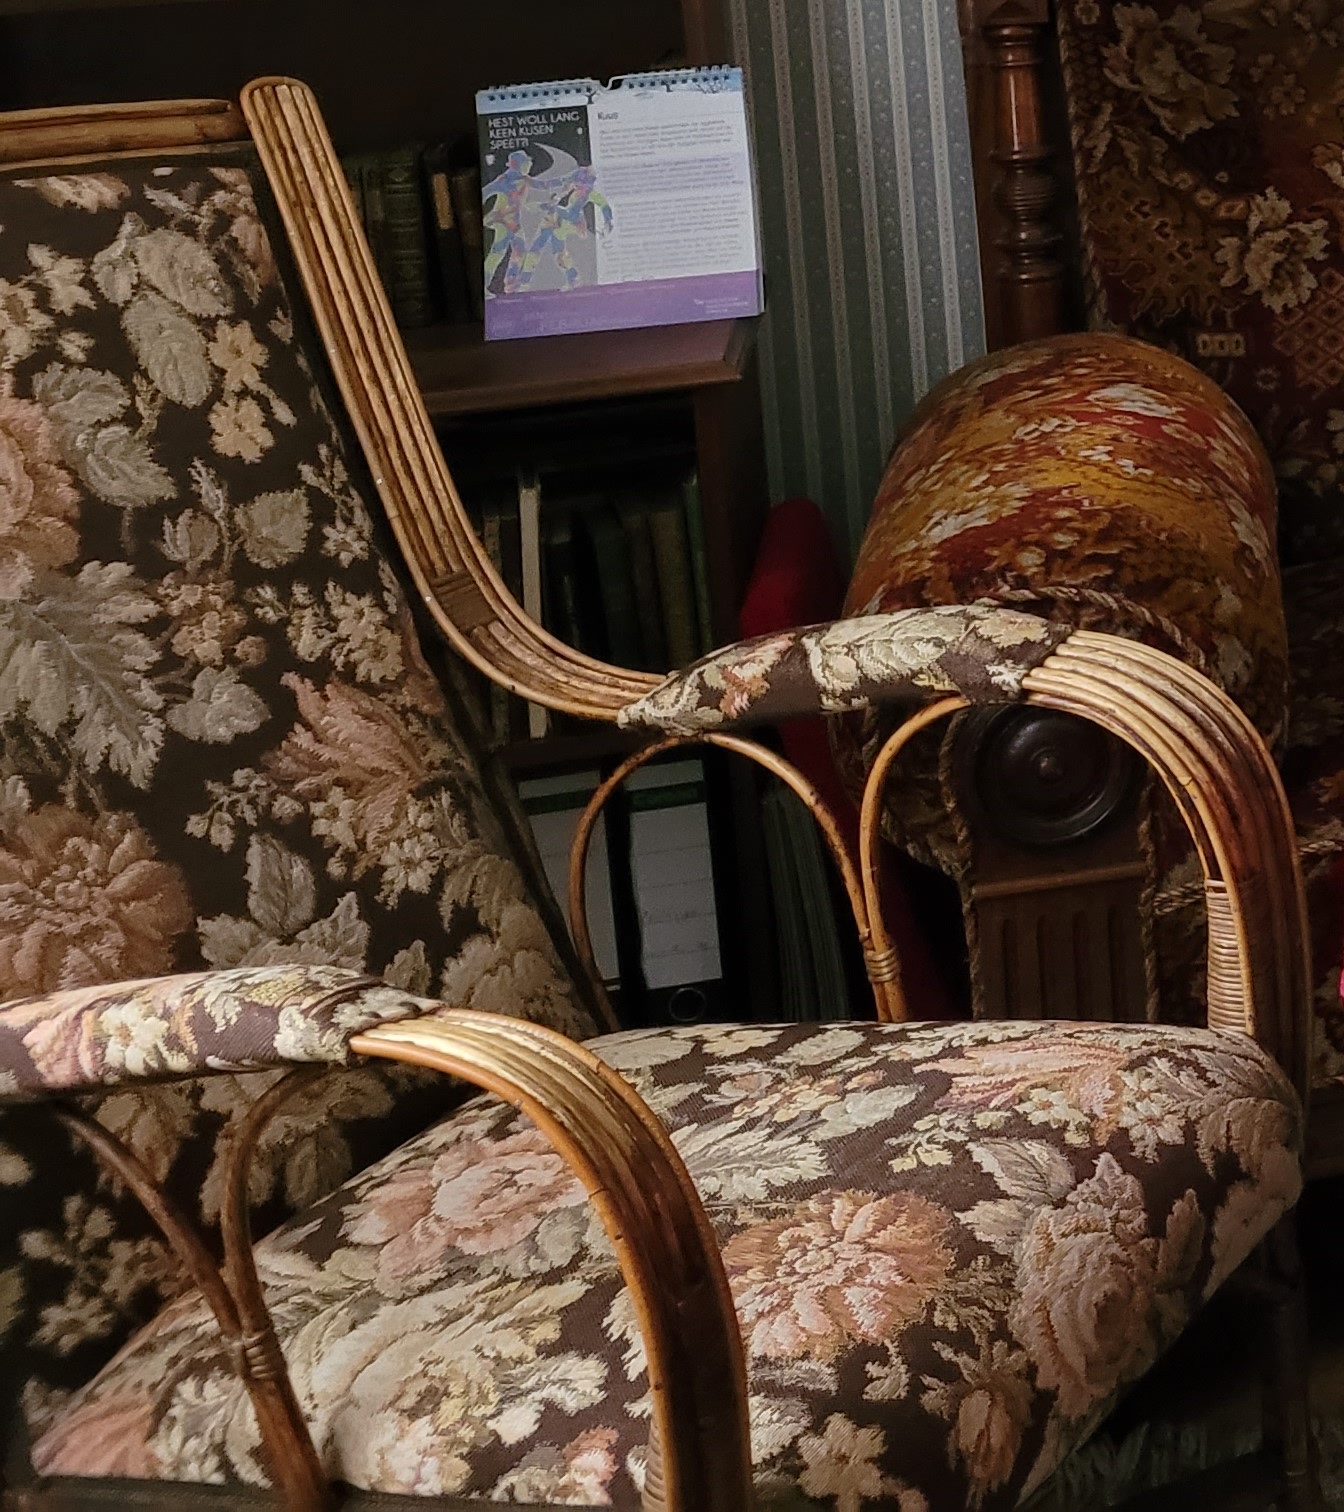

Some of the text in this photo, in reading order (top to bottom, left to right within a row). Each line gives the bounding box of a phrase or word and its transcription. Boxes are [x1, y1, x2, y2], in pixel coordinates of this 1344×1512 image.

[488, 111, 580, 128] HEST WOLL LANG
[489, 124, 554, 139] KEEN KUSEN
